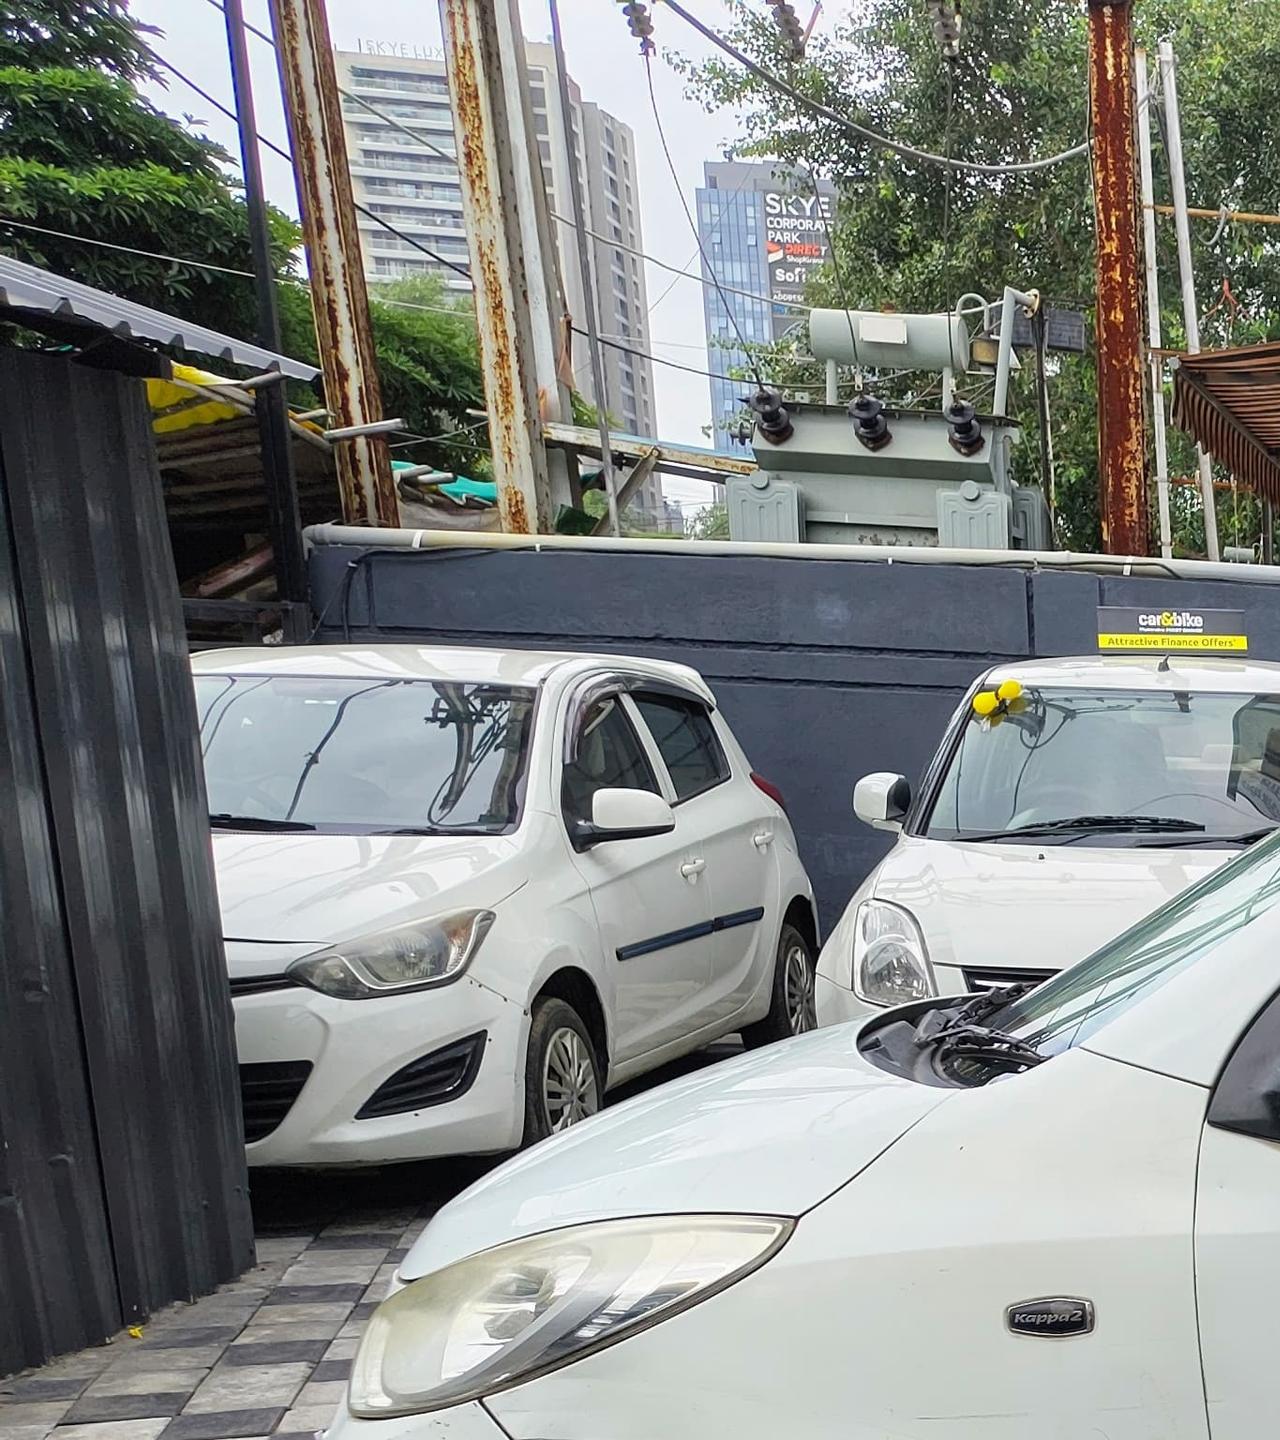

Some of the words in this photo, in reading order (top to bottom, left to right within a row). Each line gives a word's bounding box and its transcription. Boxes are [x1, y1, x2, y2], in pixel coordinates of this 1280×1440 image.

[766, 193, 831, 217] SKYE
[768, 230, 801, 243] PARK
[785, 244, 828, 256] DIRECT
[1138, 611, 1203, 627] car&bike
[1108, 637, 1159, 646] Attractive
[1161, 638, 1199, 647] Finance
